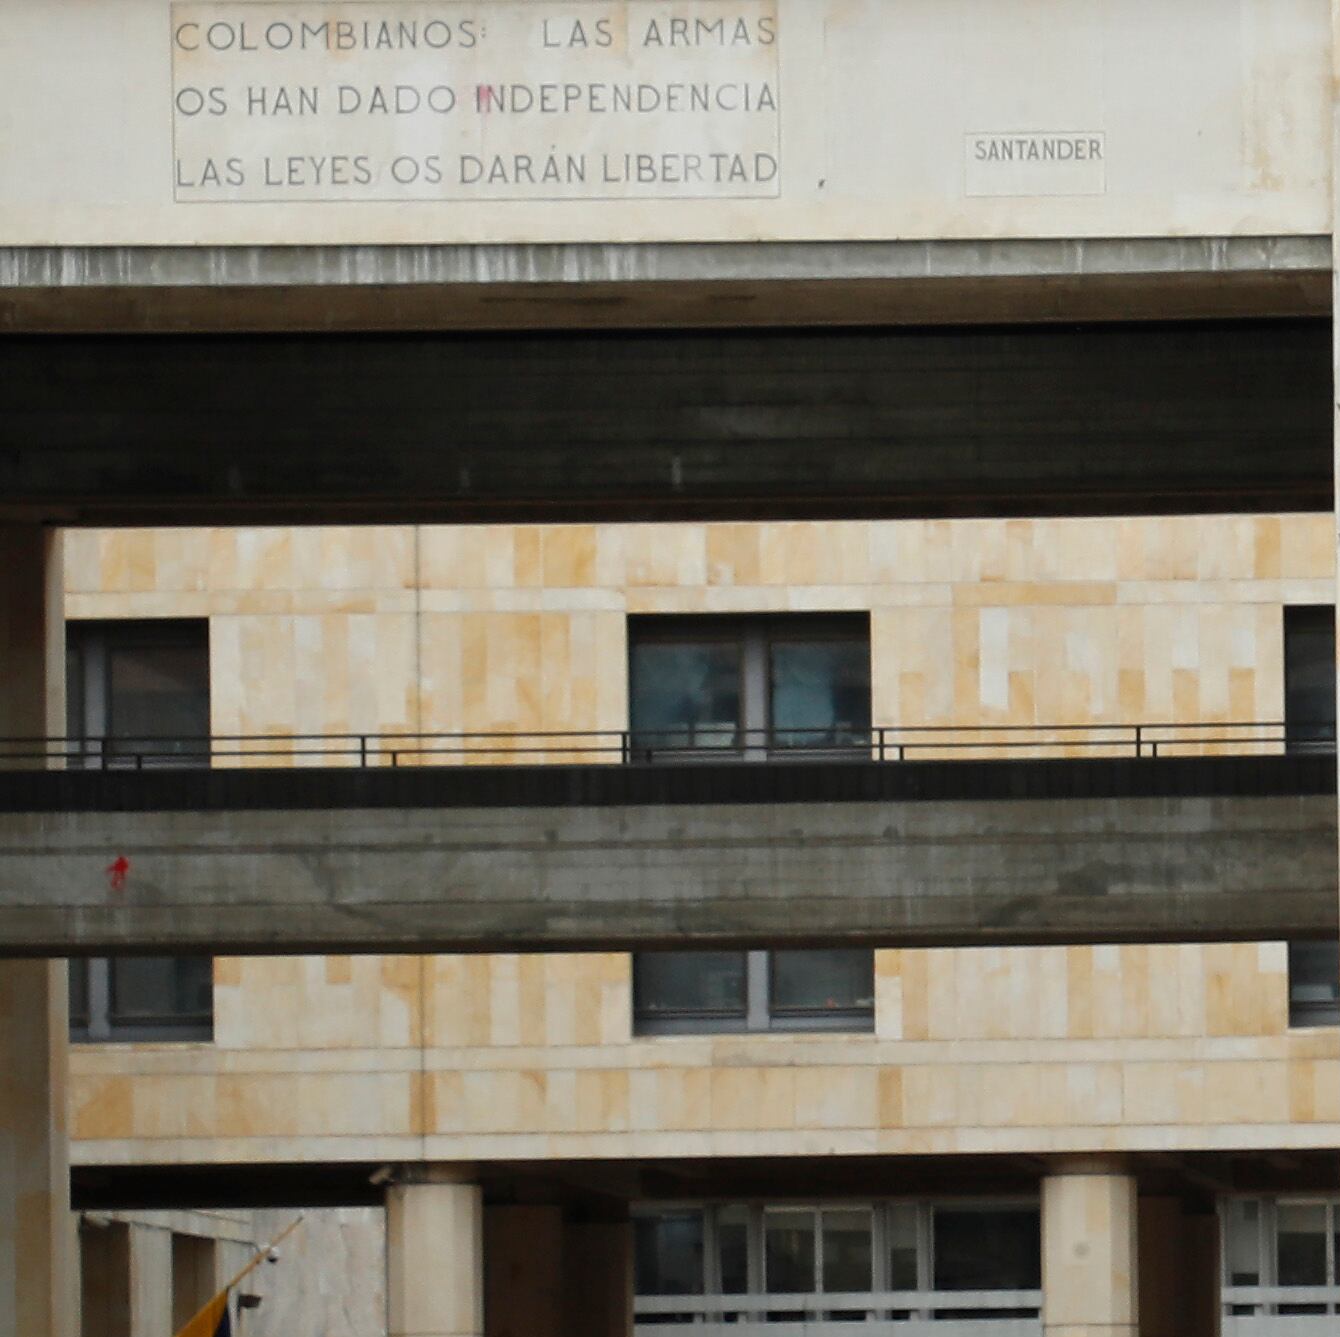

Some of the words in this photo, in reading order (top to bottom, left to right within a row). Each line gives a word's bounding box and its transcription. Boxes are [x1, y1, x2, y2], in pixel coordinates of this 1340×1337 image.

[175, 20, 487, 51] COLOMBIANOS:
[543, 19, 613, 48] LAS
[643, 17, 776, 47] ARMAS
[175, 87, 228, 116] OS
[248, 86, 318, 115] HAN
[338, 85, 456, 114] DADO
[475, 84, 777, 113] INDEPENDENCIA
[176, 157, 245, 187] LAS
[264, 155, 372, 186] LEYES
[391, 155, 442, 184] OS
[459, 145, 586, 184] DARÁN
[602, 153, 777, 183] LIBERTAD
[974, 139, 1102, 161] SANTANDER
